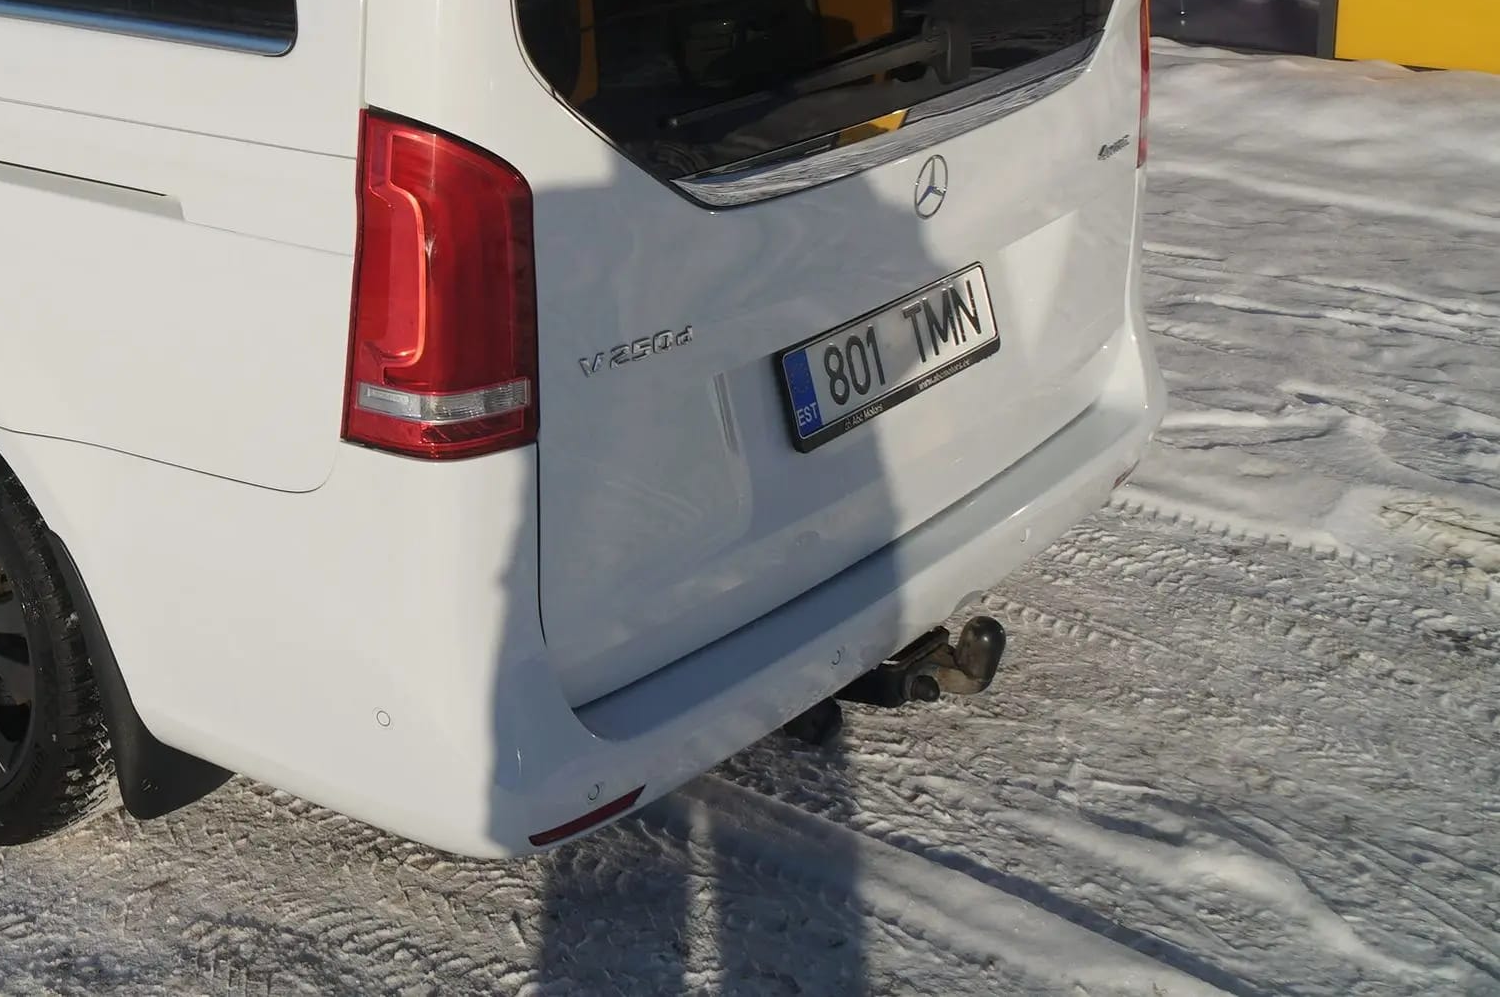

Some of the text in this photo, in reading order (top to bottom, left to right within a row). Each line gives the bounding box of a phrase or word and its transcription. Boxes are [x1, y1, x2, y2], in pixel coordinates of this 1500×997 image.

[823, 279, 982, 406] 801 TMN
[797, 402, 818, 427] EST
